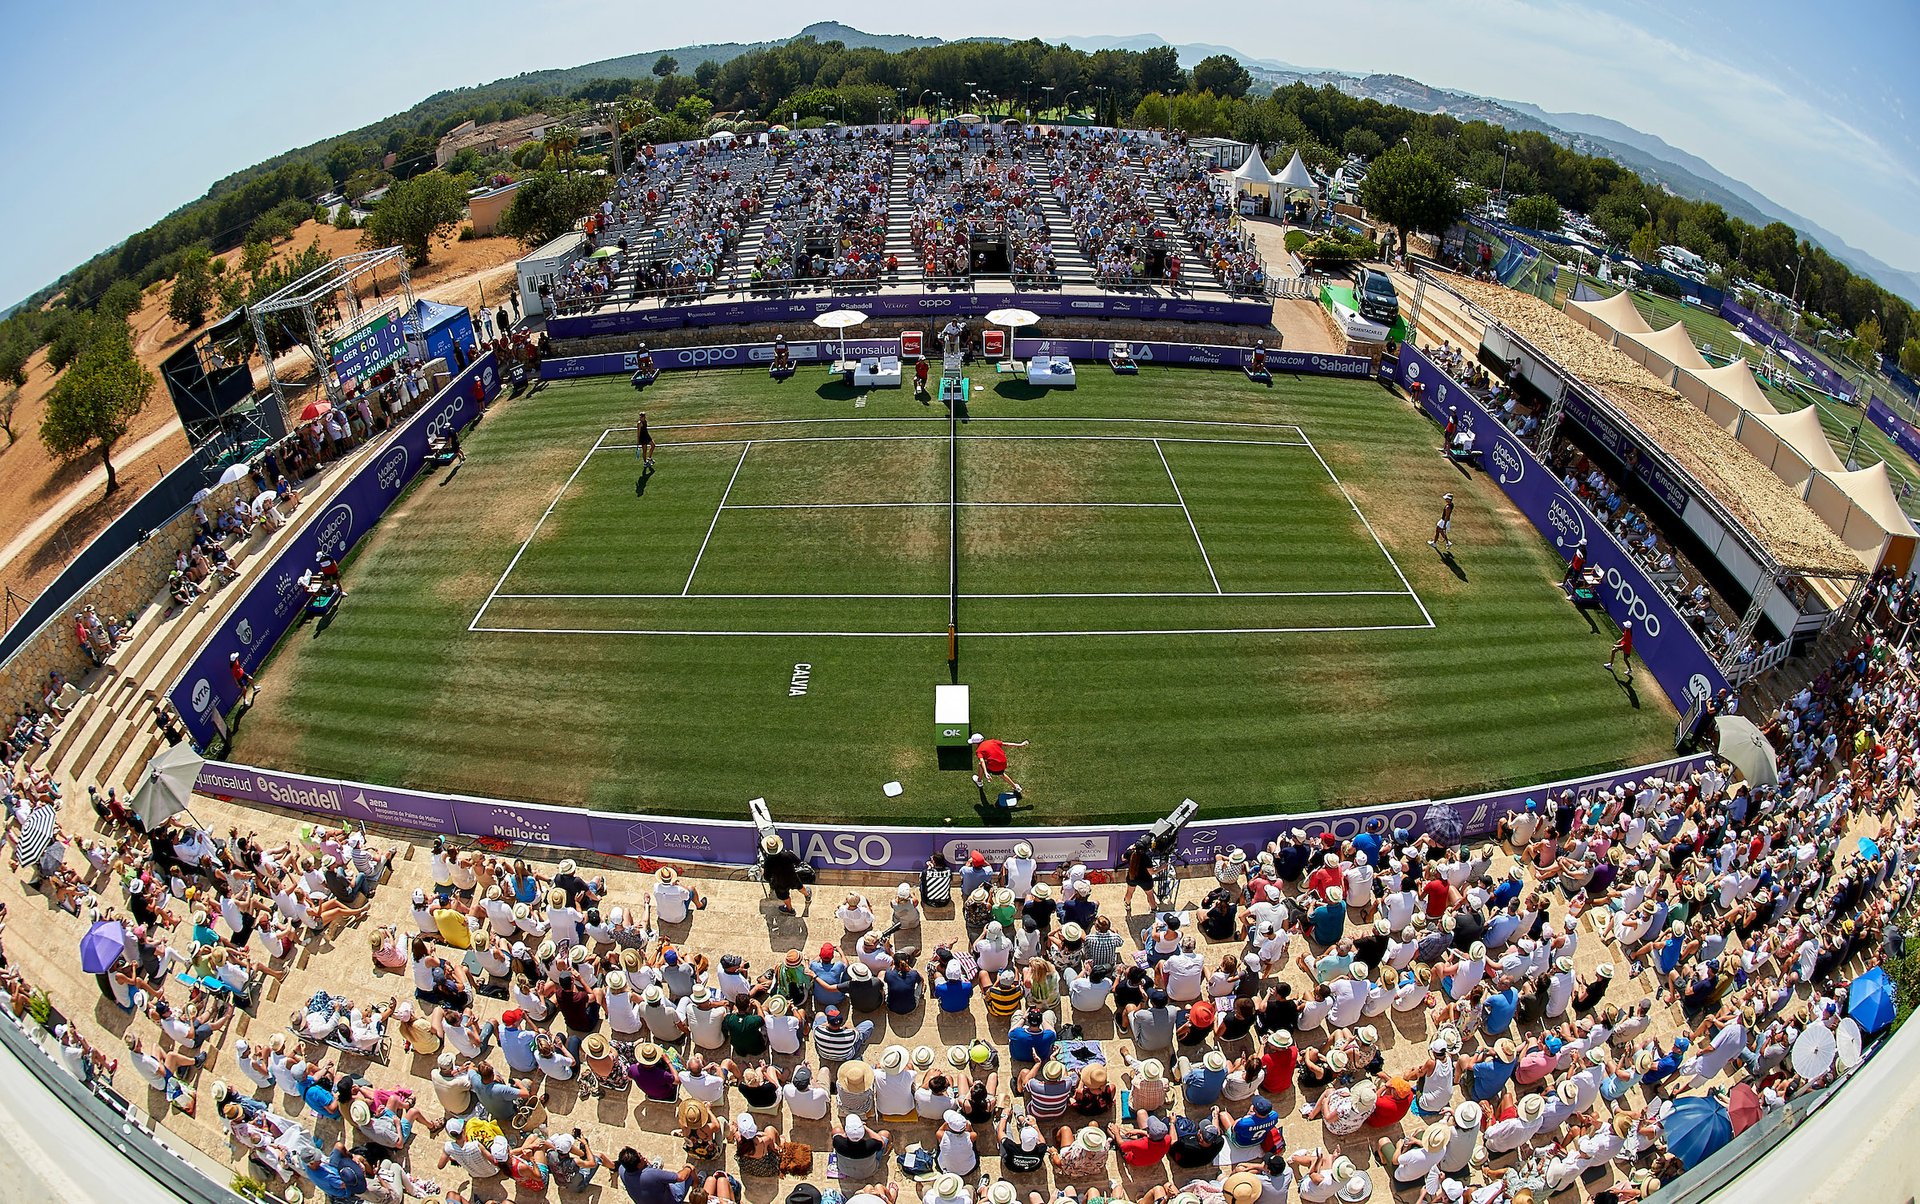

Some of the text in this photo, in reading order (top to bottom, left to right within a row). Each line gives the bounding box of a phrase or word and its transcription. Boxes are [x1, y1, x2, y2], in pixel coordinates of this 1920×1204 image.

[919, 299, 951, 308] oppo
[334, 326, 372, 356] A. KERBER
[342, 324, 397, 363] GER 6 0 0
[346, 337, 400, 378] RUS 2 0 0
[357, 346, 408, 382] M. SHARAPOVA
[677, 347, 738, 365] oppo
[1188, 355, 1221, 364] Mallorca
[1319, 358, 1369, 374] Sabadell
[1801, 355, 1817, 369] oppo
[558, 365, 585, 373] ZAFIRO
[427, 396, 464, 437] oppo
[1602, 433, 1617, 448] group
[376, 452, 403, 481] Mallorca
[1492, 452, 1509, 473] Open
[1493, 441, 1520, 473] Mallorca
[380, 469, 398, 490] Open
[1666, 494, 1682, 510] group
[1547, 509, 1568, 536] Open
[1550, 499, 1580, 536] Mallorca
[317, 511, 347, 547] Mallorca
[321, 530, 342, 555] Open
[274, 583, 300, 616] ESTATE
[1607, 567, 1661, 638] oppo
[788, 662, 812, 697] CALVIA
[193, 685, 210, 706] WTA
[942, 728, 962, 737] OK
[268, 781, 342, 811] Sabadell
[369, 798, 388, 808] aena
[375, 807, 399, 816] Aeropuerto
[425, 815, 445, 824] Mallorca
[493, 824, 550, 842] Mallorca
[662, 832, 711, 845] XARXA
[1251, 1129, 1267, 1141] 9
